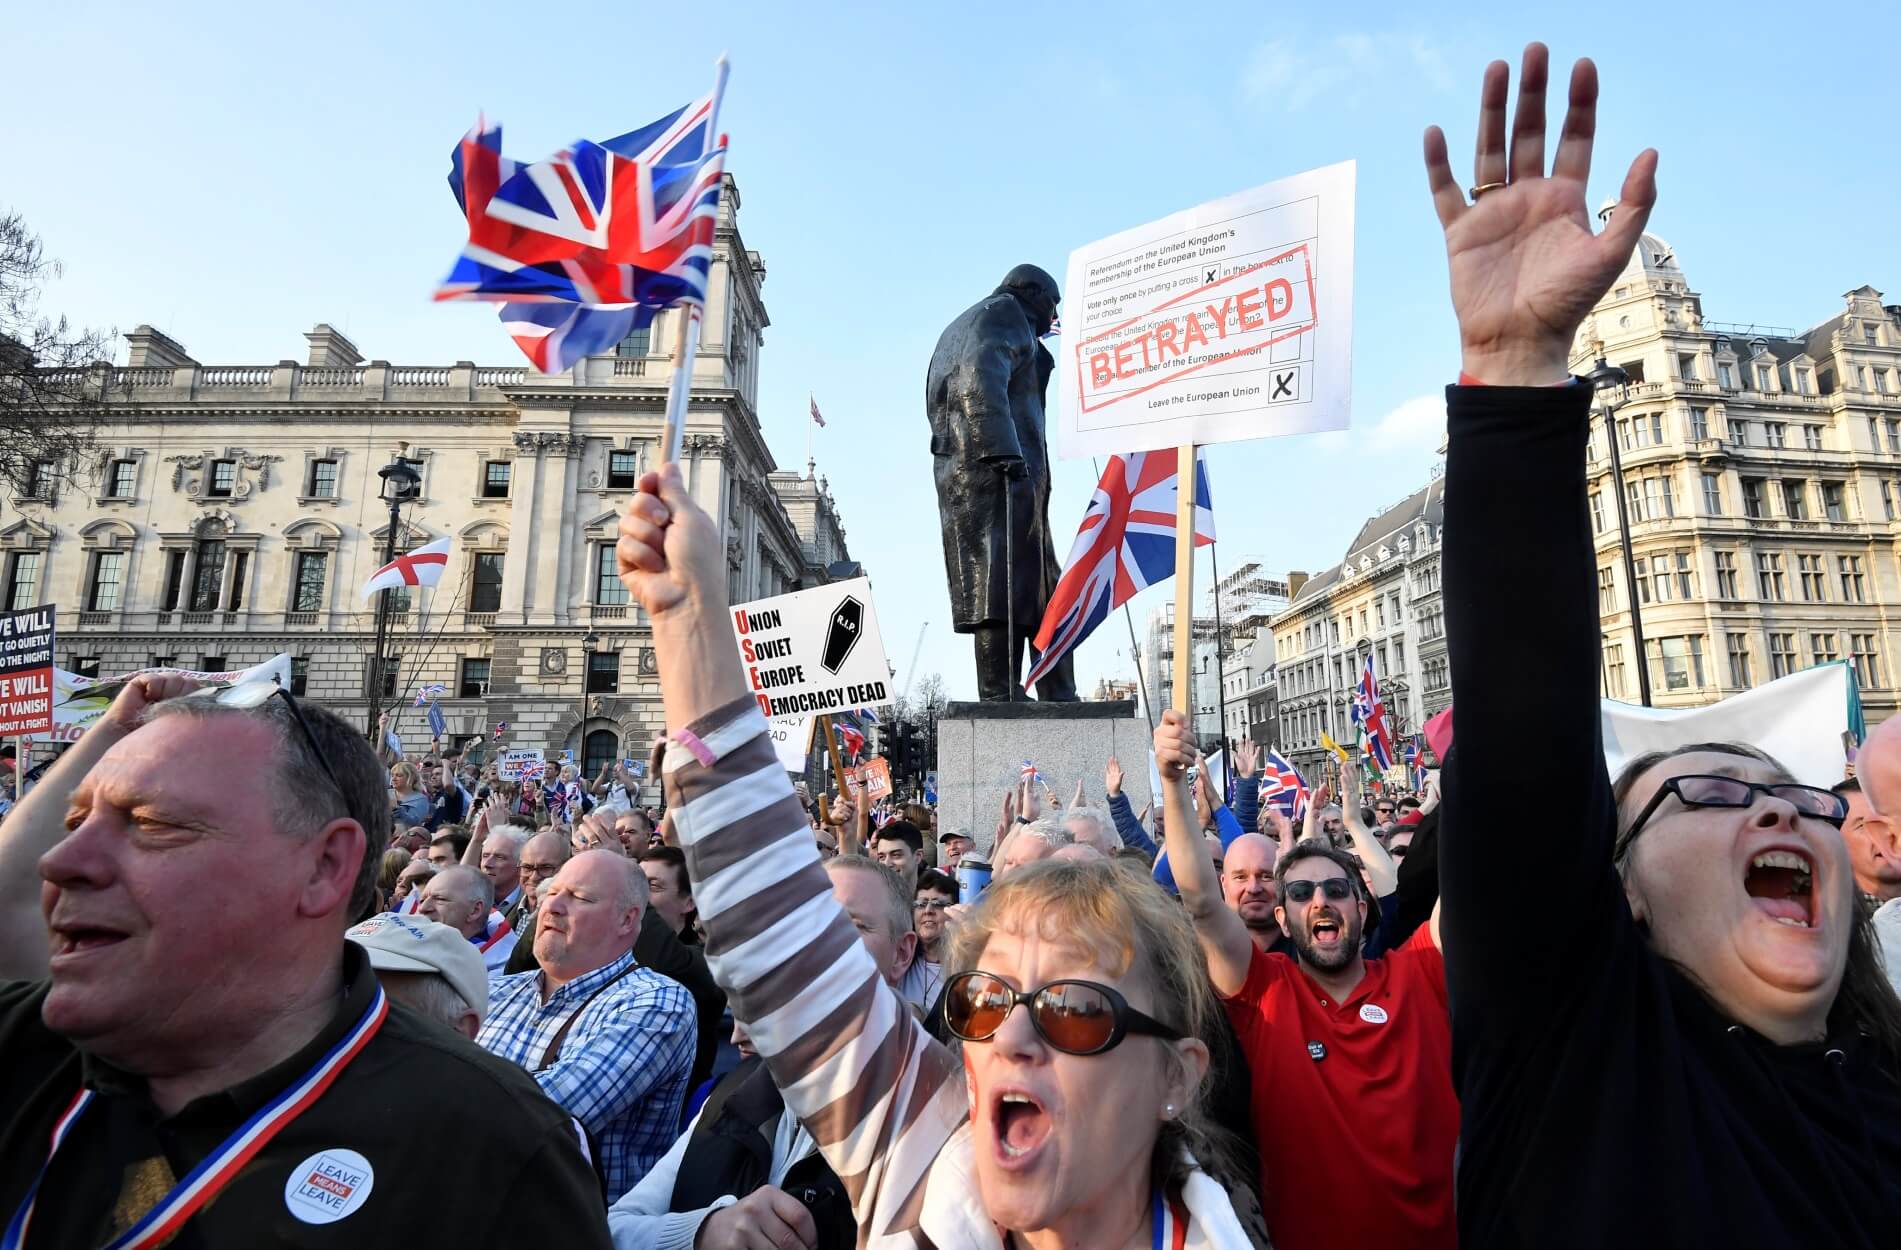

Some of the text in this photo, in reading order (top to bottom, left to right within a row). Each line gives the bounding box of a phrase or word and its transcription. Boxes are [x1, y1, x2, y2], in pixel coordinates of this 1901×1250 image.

[1091, 229, 1235, 276] Referendum on the United Kingdom's
[1089, 243, 1226, 288] membership of the European Union
[1087, 300, 1101, 310] Vote
[1103, 296, 1117, 309] only
[1120, 293, 1137, 302] once
[1138, 289, 1147, 299] by
[1148, 281, 1170, 296] putting
[1179, 275, 1198, 286] cross
[1223, 267, 1231, 276] in
[1233, 264, 1246, 275] the
[1286, 254, 1294, 263] to
[1086, 307, 1123, 323] your choice
[1111, 330, 1122, 339] the
[1124, 324, 1146, 336] United
[1182, 310, 1209, 322] rain
[1091, 277, 1293, 390] BETRAYED
[1085, 342, 1119, 355] European
[1163, 360, 1171, 369] of
[1172, 358, 1185, 367] the
[1149, 386, 1260, 409] Leave the European Union
[0, 610, 51, 636] E WILL
[836, 614, 856, 633] R.I.P.
[5, 639, 17, 652] GO
[18, 633, 51, 649] QUIETLY
[7, 654, 22, 666] THE
[23, 649, 50, 665] NIGHT!
[0, 679, 10, 698] E
[13, 674, 49, 696] WILL
[847, 681, 886, 705] DEAD
[10, 698, 48, 716] VANISH
[0, 717, 49, 732] HOUT A FIGHT!
[313, 1176, 347, 1195] MEANS
[317, 1162, 361, 1187] LEAVE
[299, 1183, 344, 1209] LEAVE
